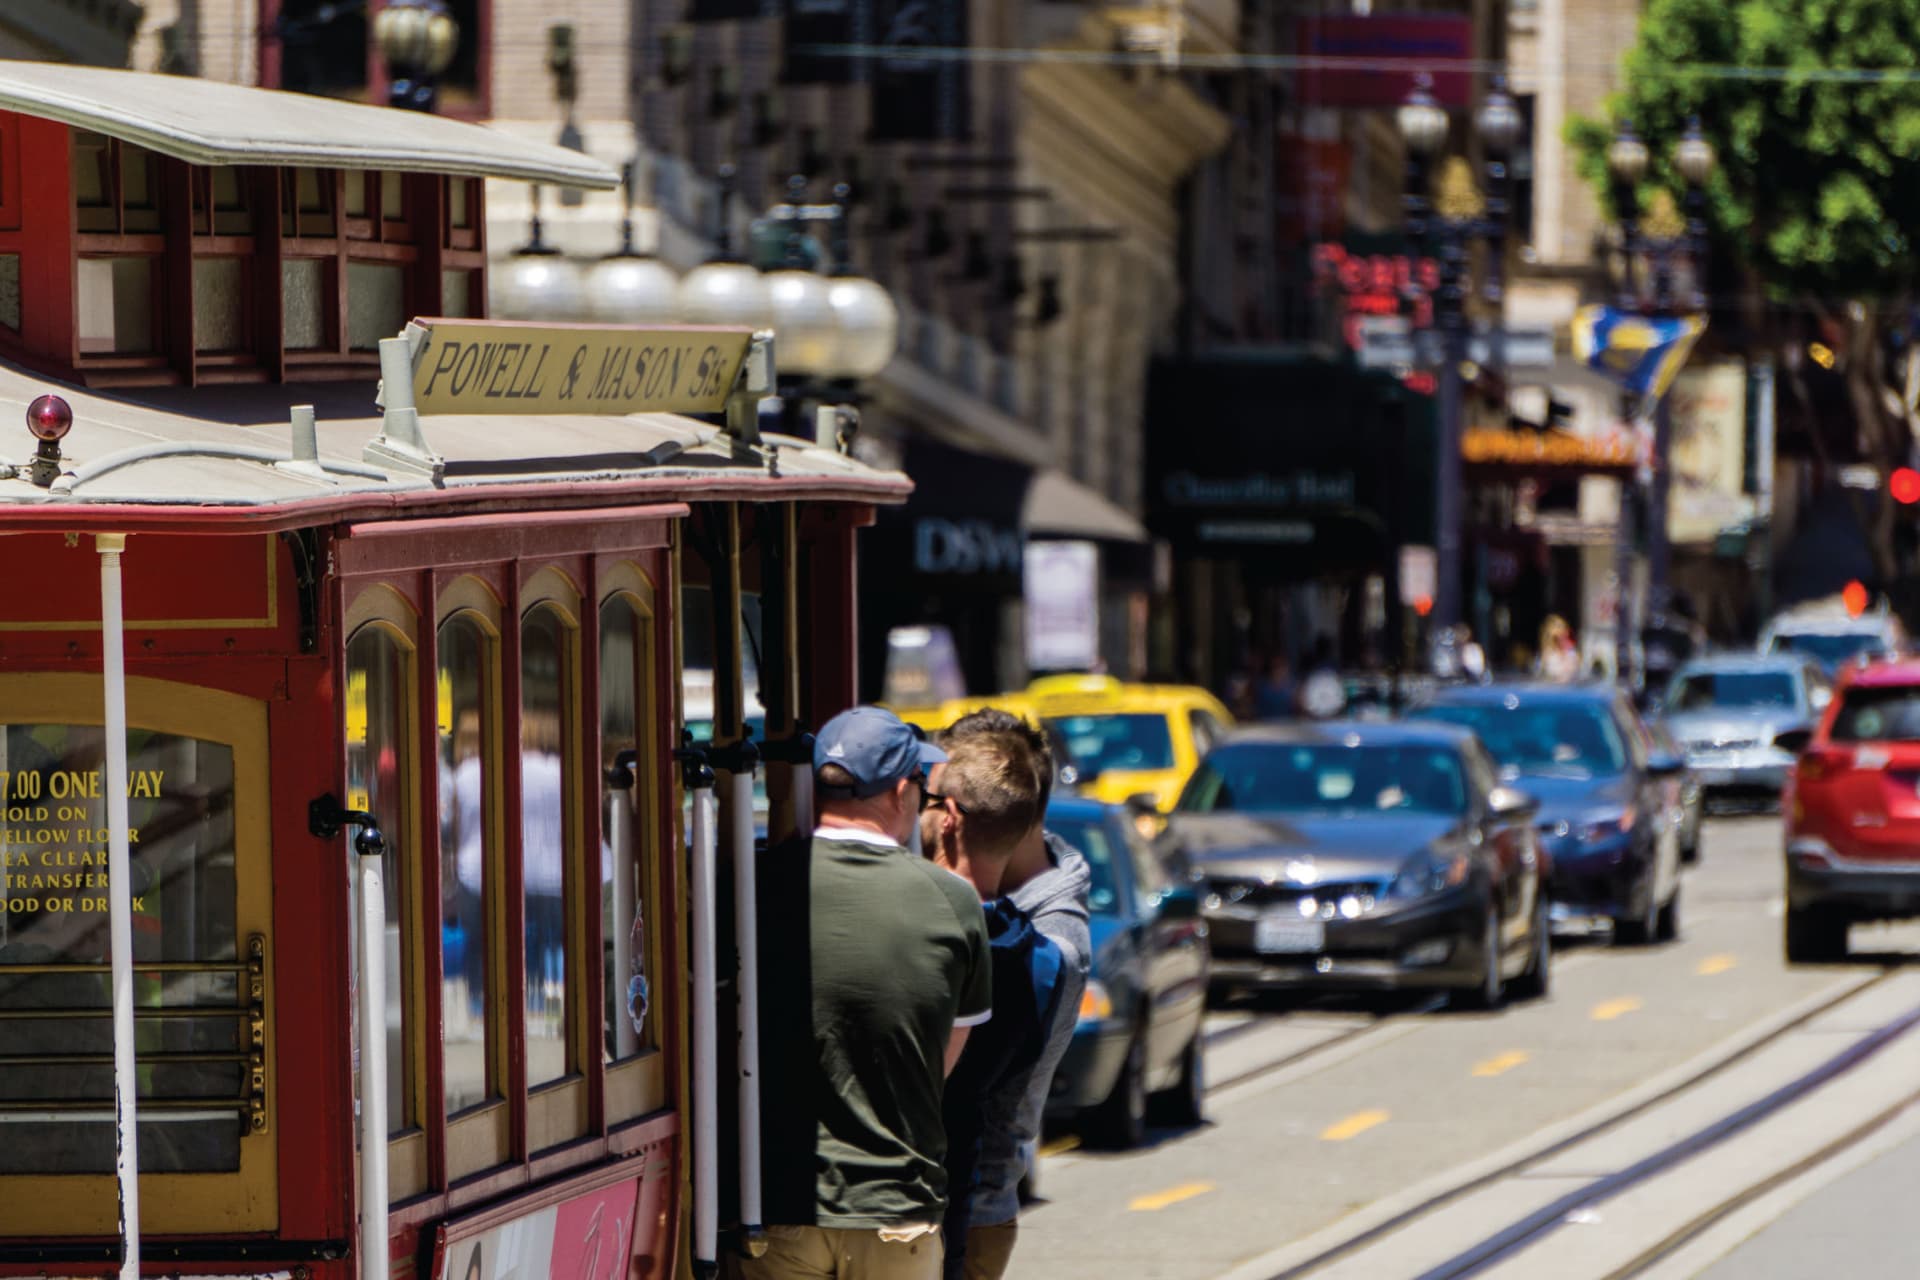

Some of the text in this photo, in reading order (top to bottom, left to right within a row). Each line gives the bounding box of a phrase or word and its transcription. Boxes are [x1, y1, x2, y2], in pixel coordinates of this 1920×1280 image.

[424, 342, 550, 398] POWELL
[558, 345, 587, 400] &
[587, 347, 692, 399] MASON
[49, 771, 102, 799] ONE
[57, 807, 87, 821] ON
[77, 828, 140, 844] FLOR
[41, 851, 108, 866] CLEAR
[46, 898, 74, 912] OR
[82, 897, 144, 912] DRK
